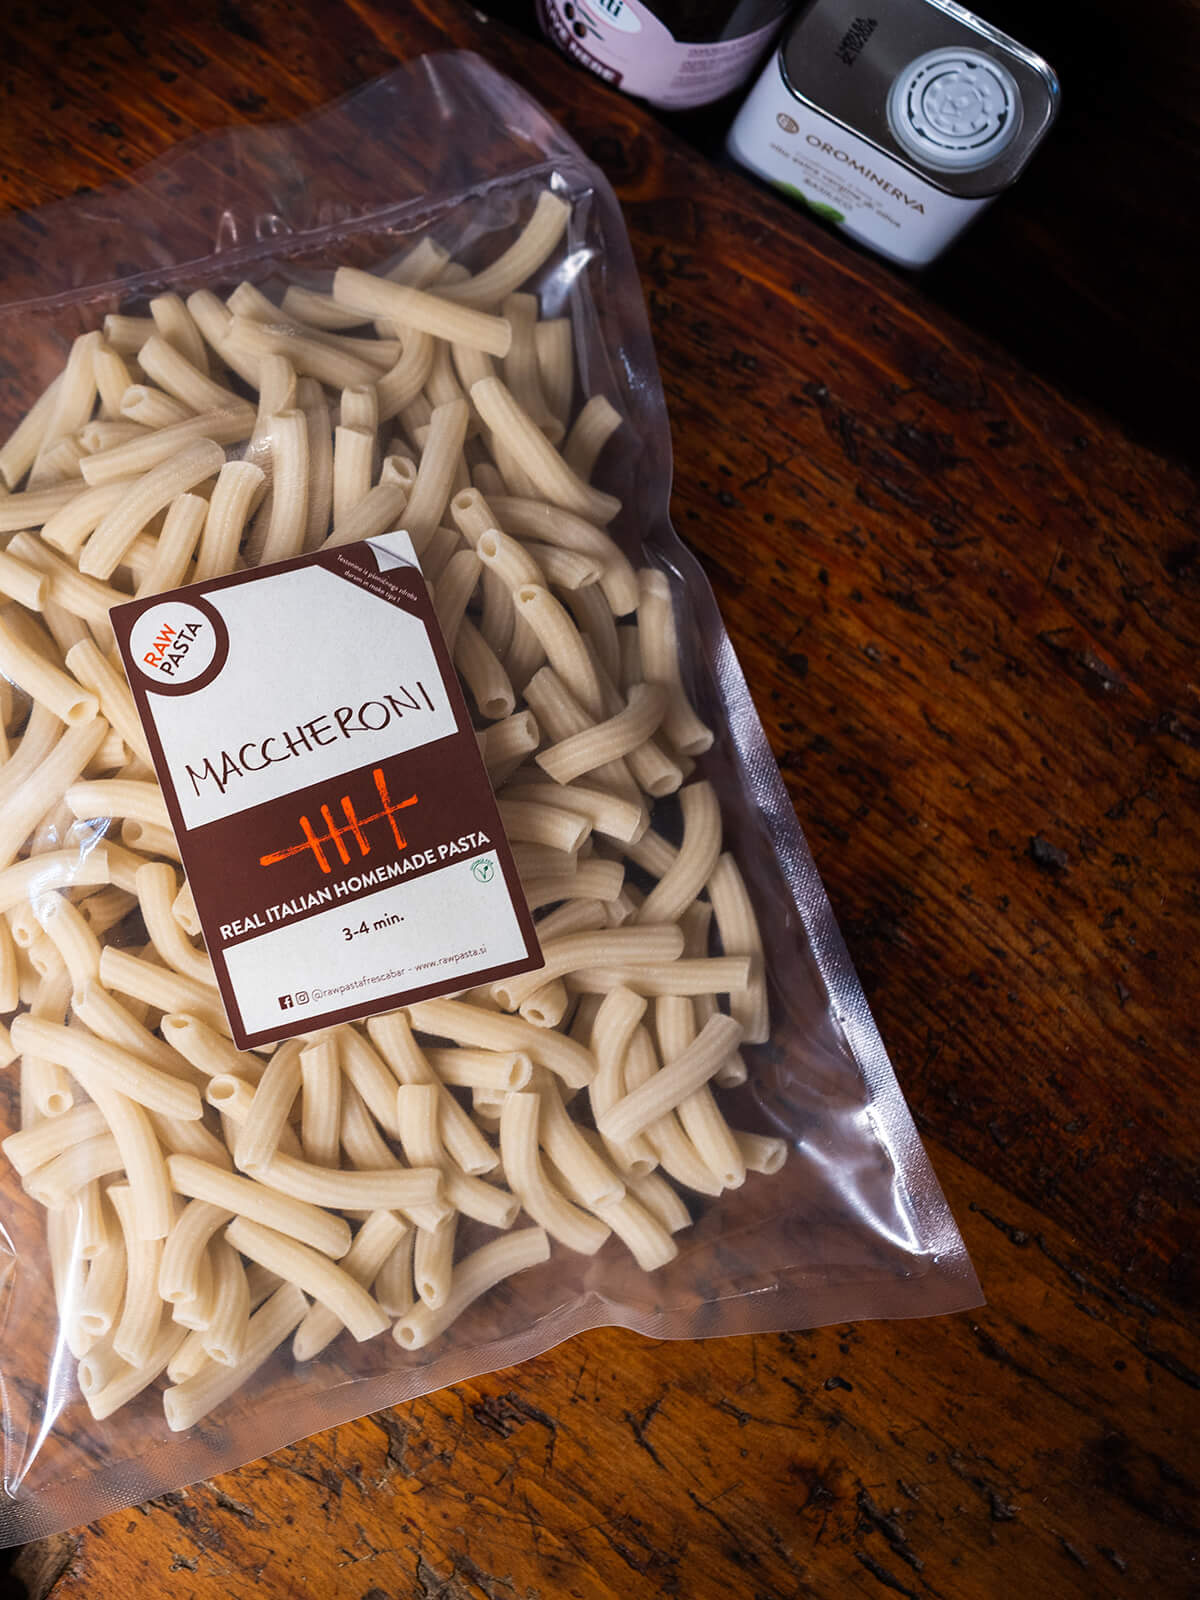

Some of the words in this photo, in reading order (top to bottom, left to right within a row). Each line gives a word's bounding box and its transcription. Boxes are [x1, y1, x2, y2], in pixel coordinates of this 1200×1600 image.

[805, 134, 925, 215] OROMINERVA
[344, 569, 363, 583] durum
[143, 623, 177, 668] RAW
[160, 623, 203, 676] PASTA
[184, 681, 436, 798] MACCHERONI
[219, 913, 266, 940] REAL
[265, 887, 333, 923] ITALIAN
[333, 849, 438, 898] HOMEMADE
[437, 831, 491, 860] PASTA
[341, 920, 370, 941] 3-4
[373, 913, 405, 931] min.
[311, 966, 406, 1001] @rawpastafrescabar
[414, 944, 488, 973] www.rawpasta.si
